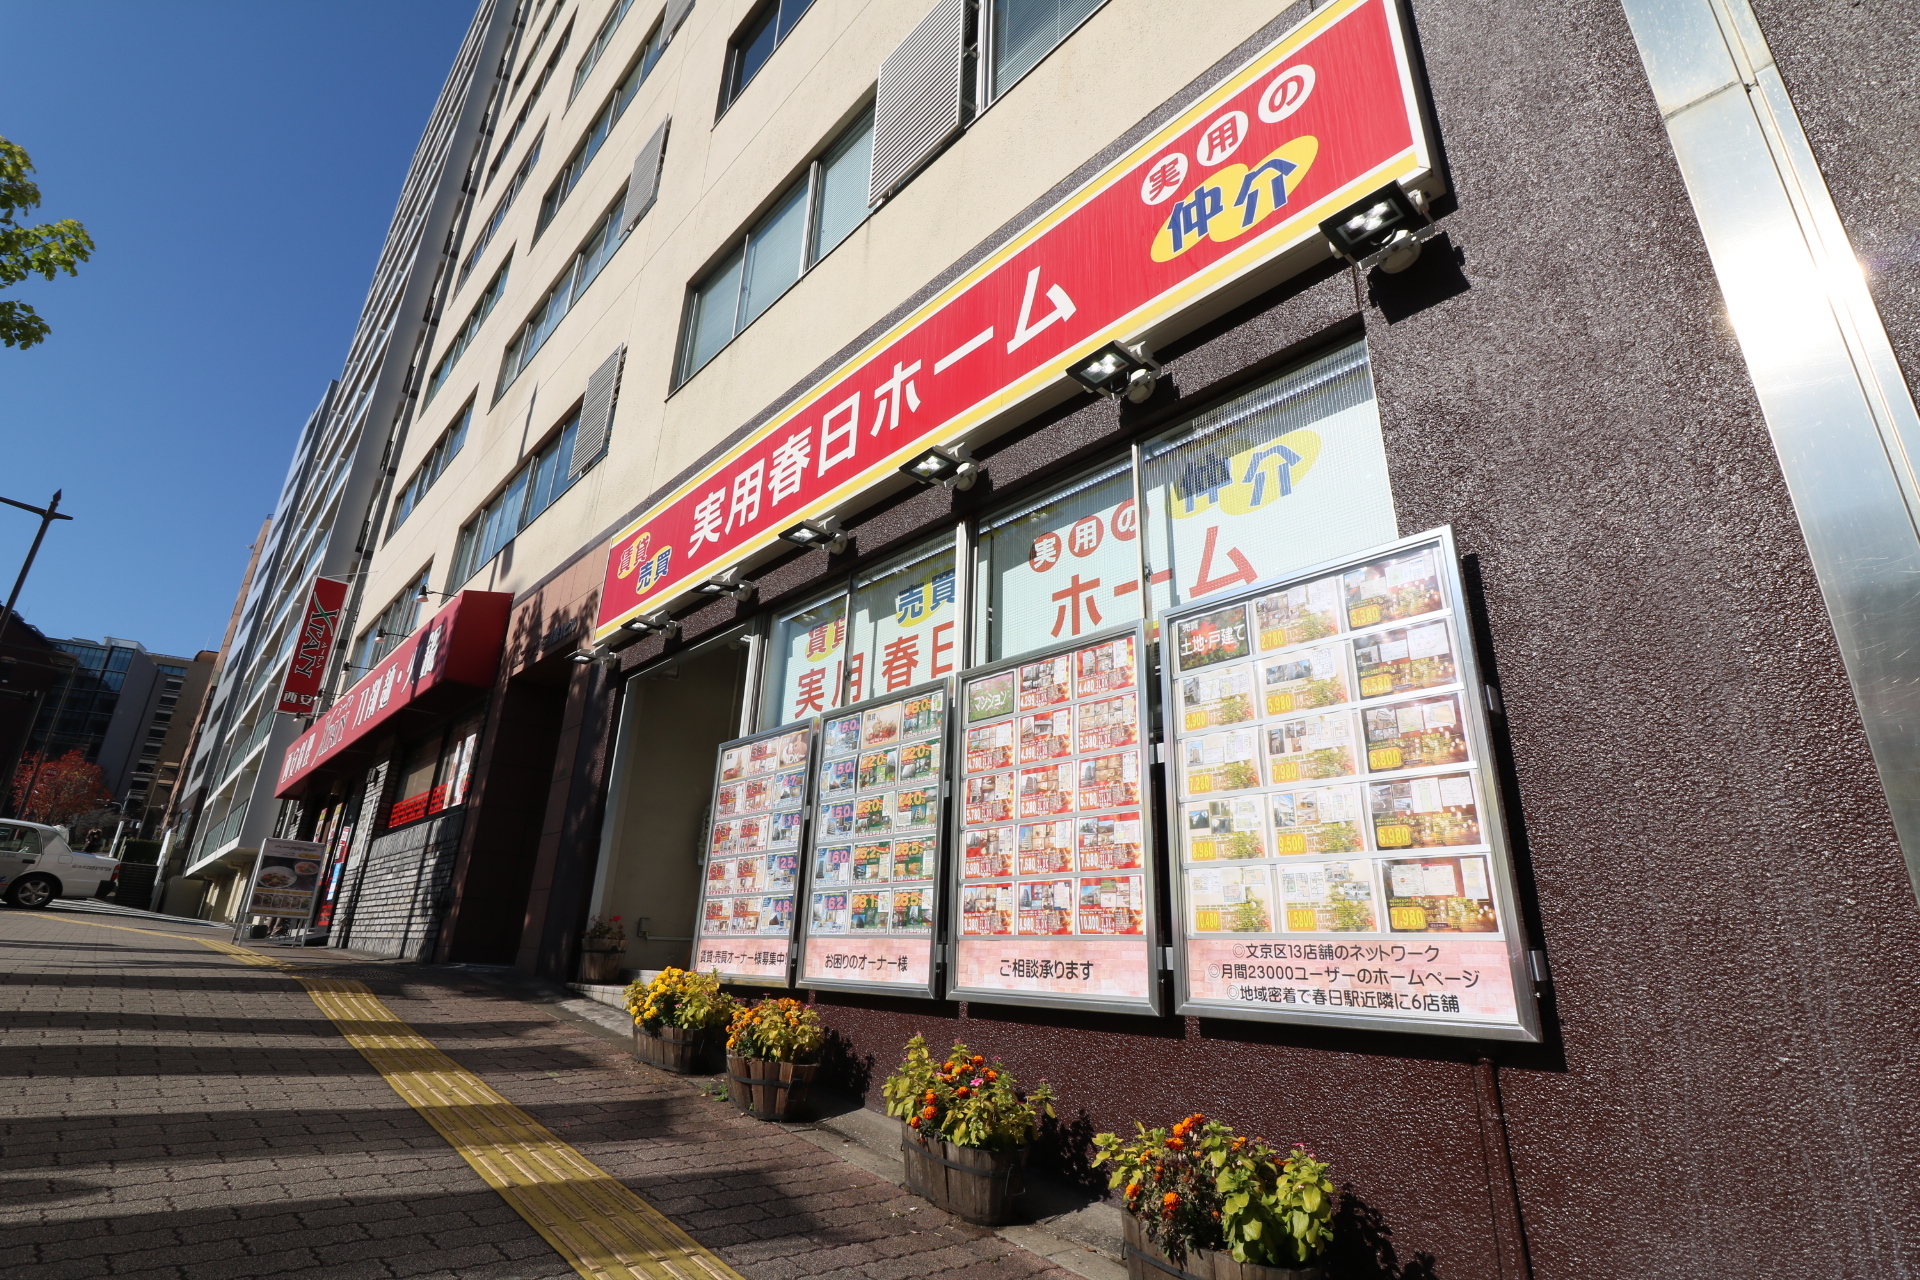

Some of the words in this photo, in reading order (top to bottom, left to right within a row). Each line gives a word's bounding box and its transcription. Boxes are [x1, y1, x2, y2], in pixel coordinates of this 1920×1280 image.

[1147, 80, 1301, 202] 実用の
[1167, 158, 1298, 253] 仲介
[686, 265, 1077, 560] 実用春日ホーム
[1179, 445, 1302, 515] 仲介
[617, 534, 652, 579] 賃貸
[1034, 505, 1138, 565] 実用の
[637, 547, 672, 594] 売買
[1180, 623, 1246, 657] 土地・戸建て
[283, 690, 314, 706] 西安
[825, 953, 908, 972] お困りのオーナー様
[999, 958, 1094, 981] ご相談承ります
